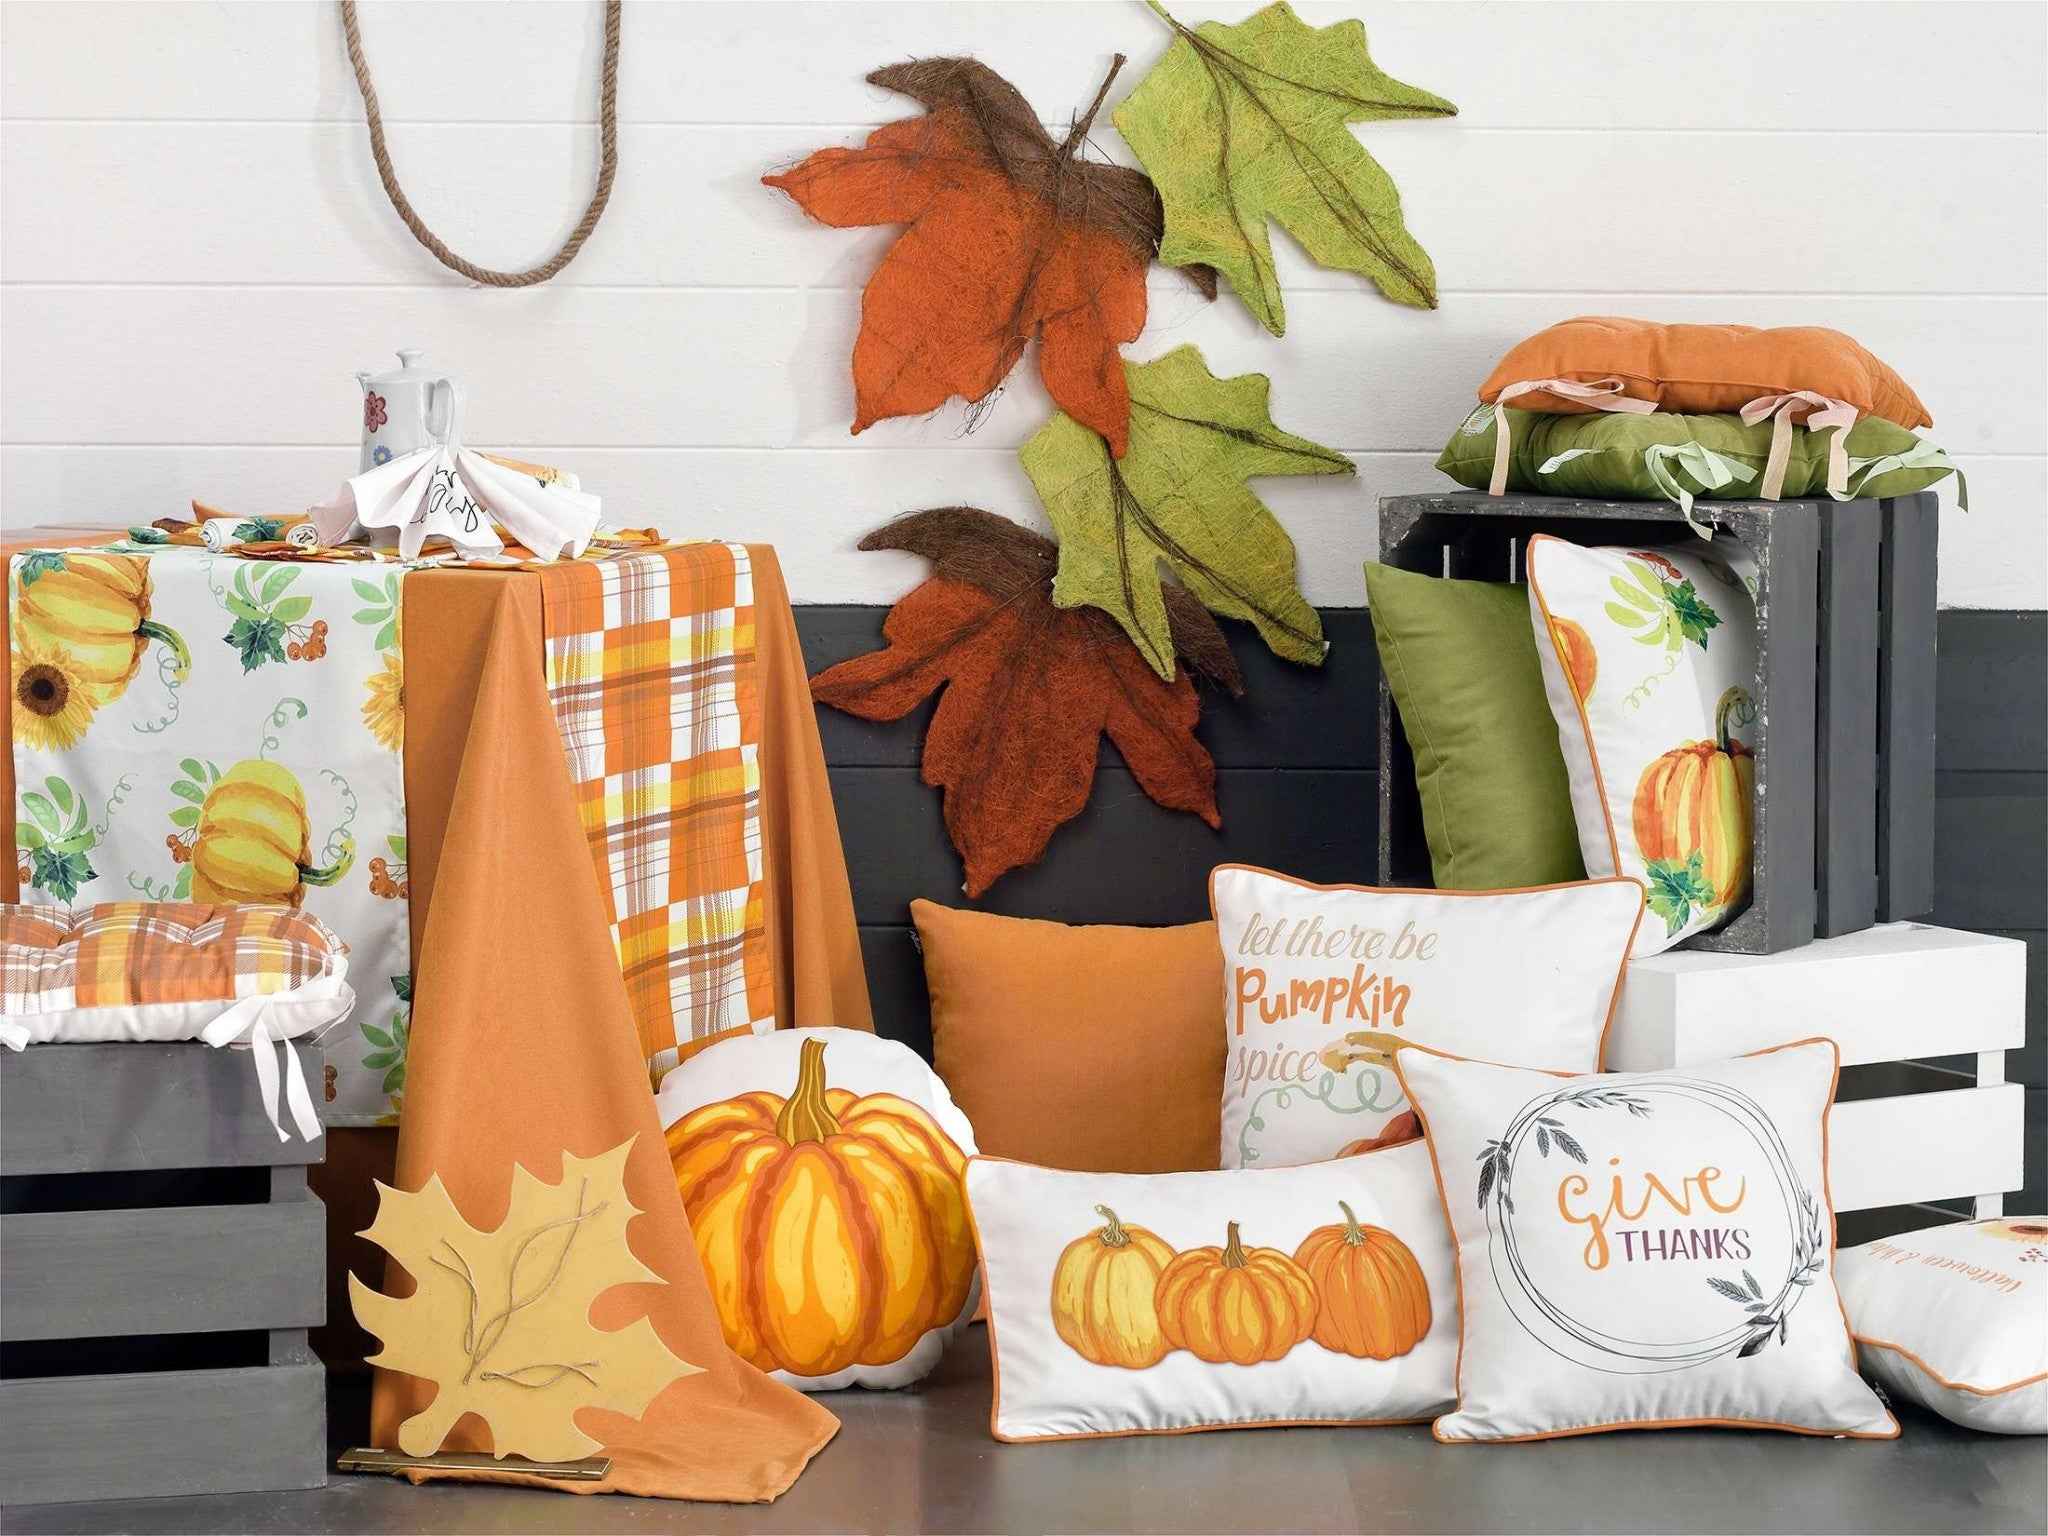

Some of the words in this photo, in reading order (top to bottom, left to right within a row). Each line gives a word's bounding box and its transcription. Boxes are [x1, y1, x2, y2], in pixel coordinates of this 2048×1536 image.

[1238, 912, 1287, 958] let
[1285, 914, 1386, 959] there
[1390, 920, 1438, 960] be
[1233, 1043, 1318, 1098] spice
[1558, 1158, 1745, 1270] give
[1616, 1228, 1751, 1262] THANKS
